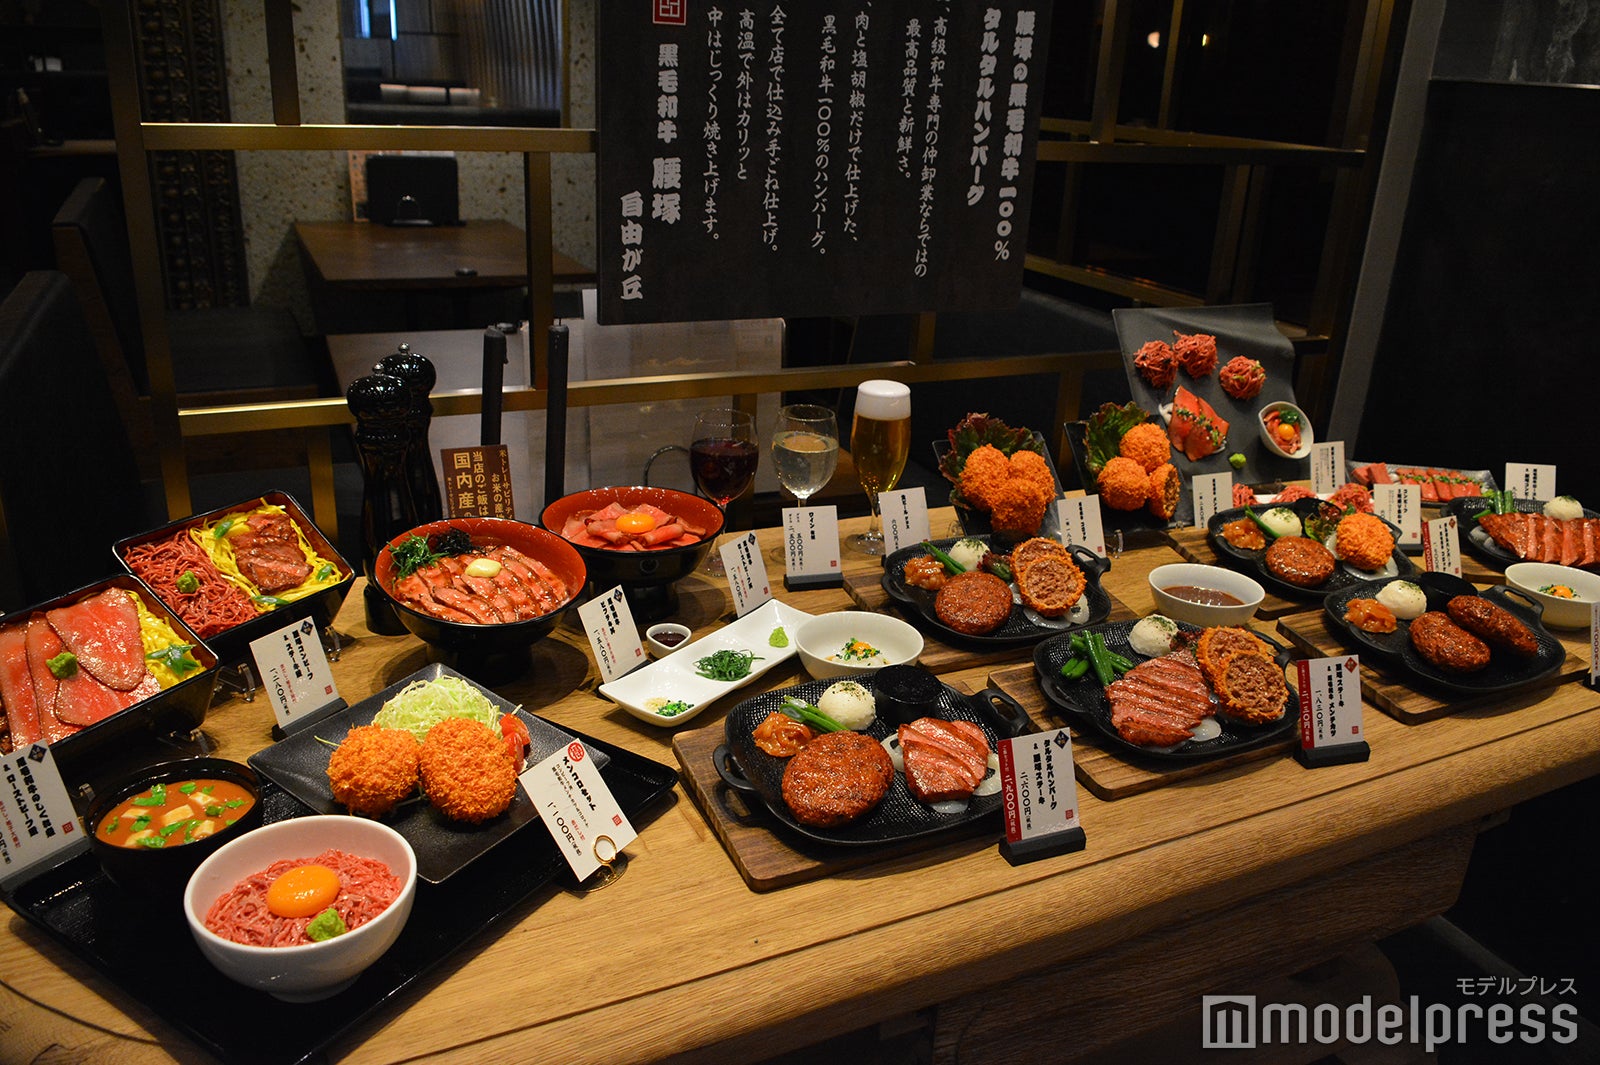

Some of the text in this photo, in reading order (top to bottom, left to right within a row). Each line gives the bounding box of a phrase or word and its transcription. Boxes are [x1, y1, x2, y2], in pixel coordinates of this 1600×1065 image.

[703, 6, 724, 240] 中はじっくり焼き上げます。
[735, 8, 756, 180] 高温で外はカリッと
[762, 4, 788, 252] 全て店で仕込み手ごね仕上げ。
[897, 18, 923, 179] 最高品質と新鮮さ。
[967, 8, 1001, 207] タルタルハンバーグ
[620, 191, 643, 300] 自由が丘
[473, 451, 489, 516] 当店のご飯は
[1044, 739, 1057, 810] タルタルハンバーグ
